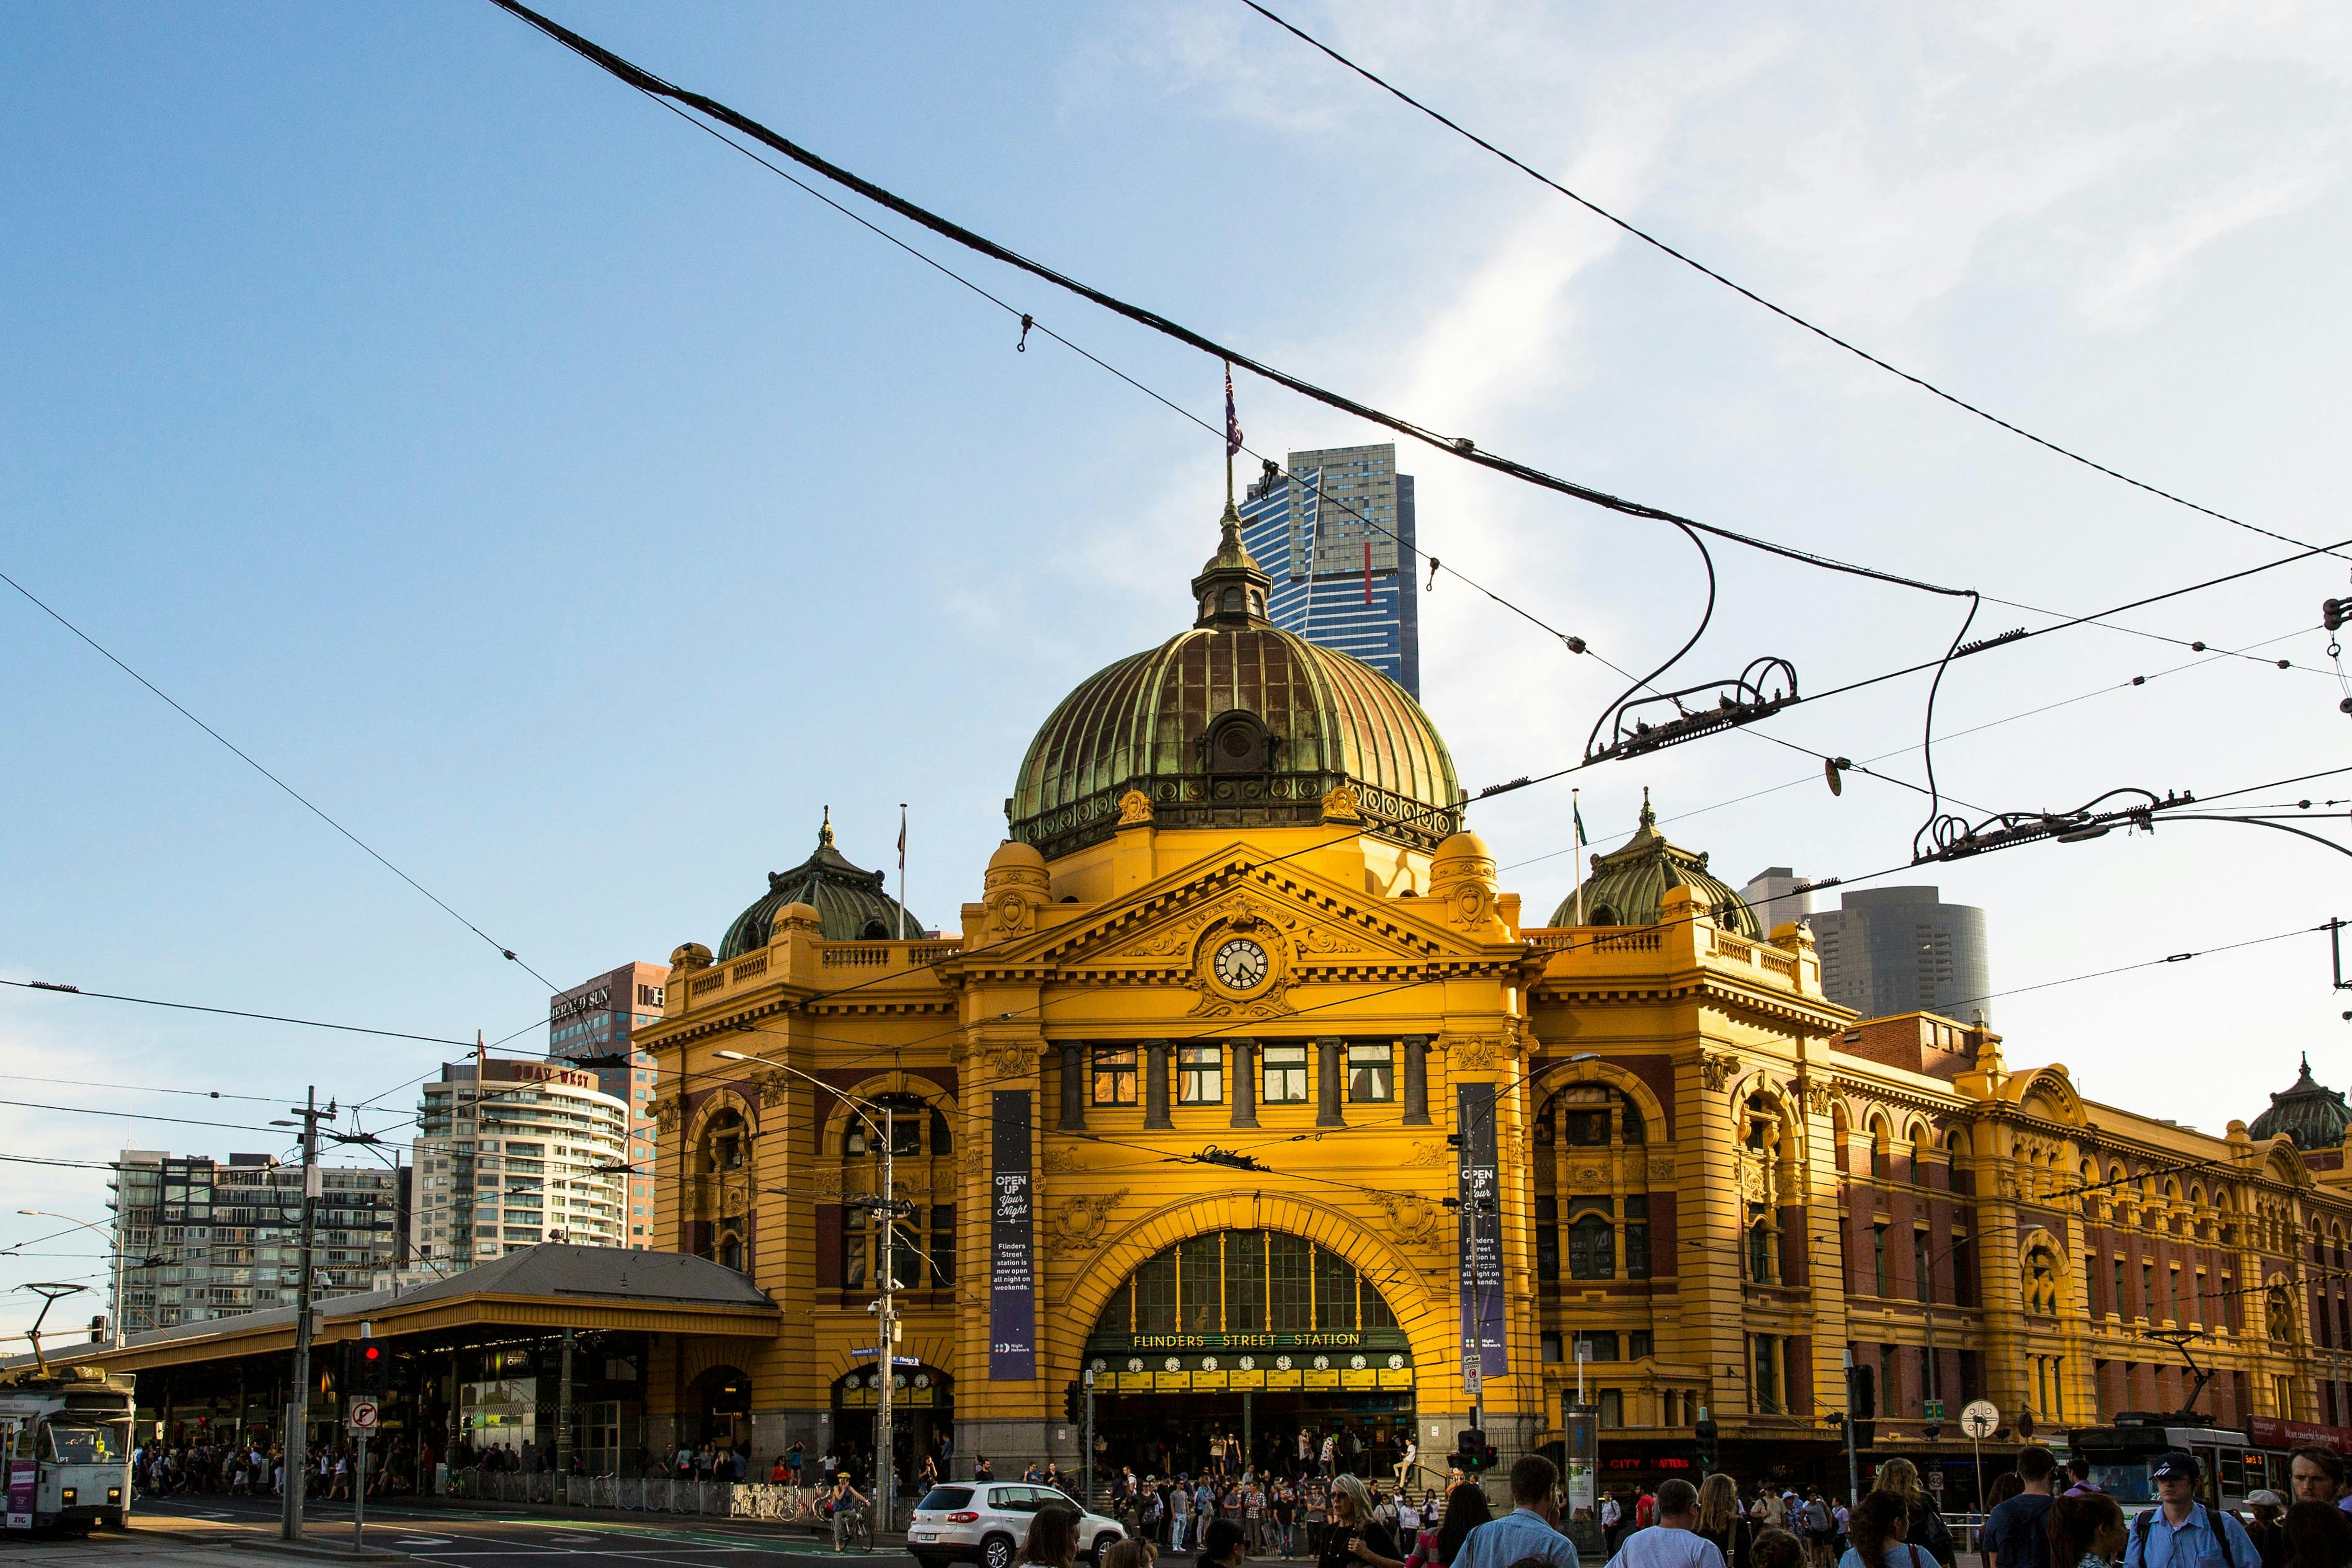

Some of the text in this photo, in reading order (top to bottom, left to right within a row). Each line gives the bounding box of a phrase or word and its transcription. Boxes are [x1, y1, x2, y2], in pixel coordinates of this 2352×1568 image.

[589, 988, 608, 1006] SUN
[515, 1064, 589, 1088] QUAY WEST
[996, 1175, 1027, 1185] OPEN
[1461, 1169, 1493, 1180] OPEN
[1004, 1185, 1019, 1194] UP
[999, 1195, 1025, 1207] Your
[997, 1204, 1028, 1218] Night
[1134, 1333, 1361, 1347] FLINDERS STREET STATION
[1610, 1459, 1641, 1469] CITY
